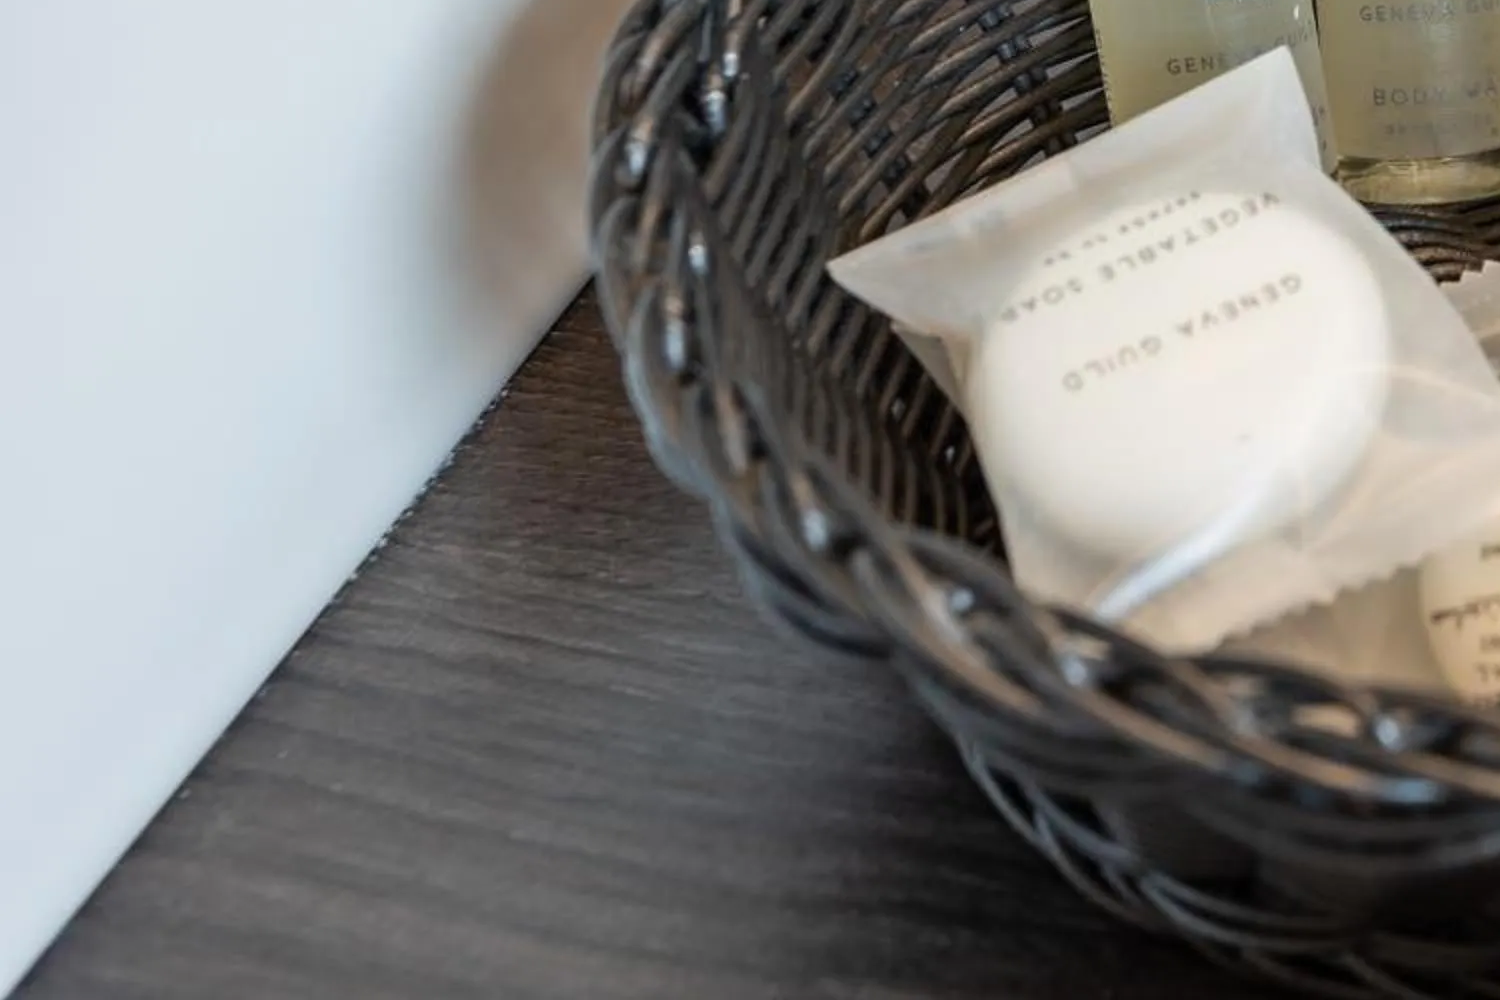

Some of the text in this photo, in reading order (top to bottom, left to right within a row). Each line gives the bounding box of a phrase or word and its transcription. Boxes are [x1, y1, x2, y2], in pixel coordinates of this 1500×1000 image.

[1358, 1, 1455, 23] GENEVA
[1098, 192, 1282, 284] VEGETABLE
[998, 278, 1083, 324] SOAP
[1061, 274, 1303, 394] GENEVA GUILD
